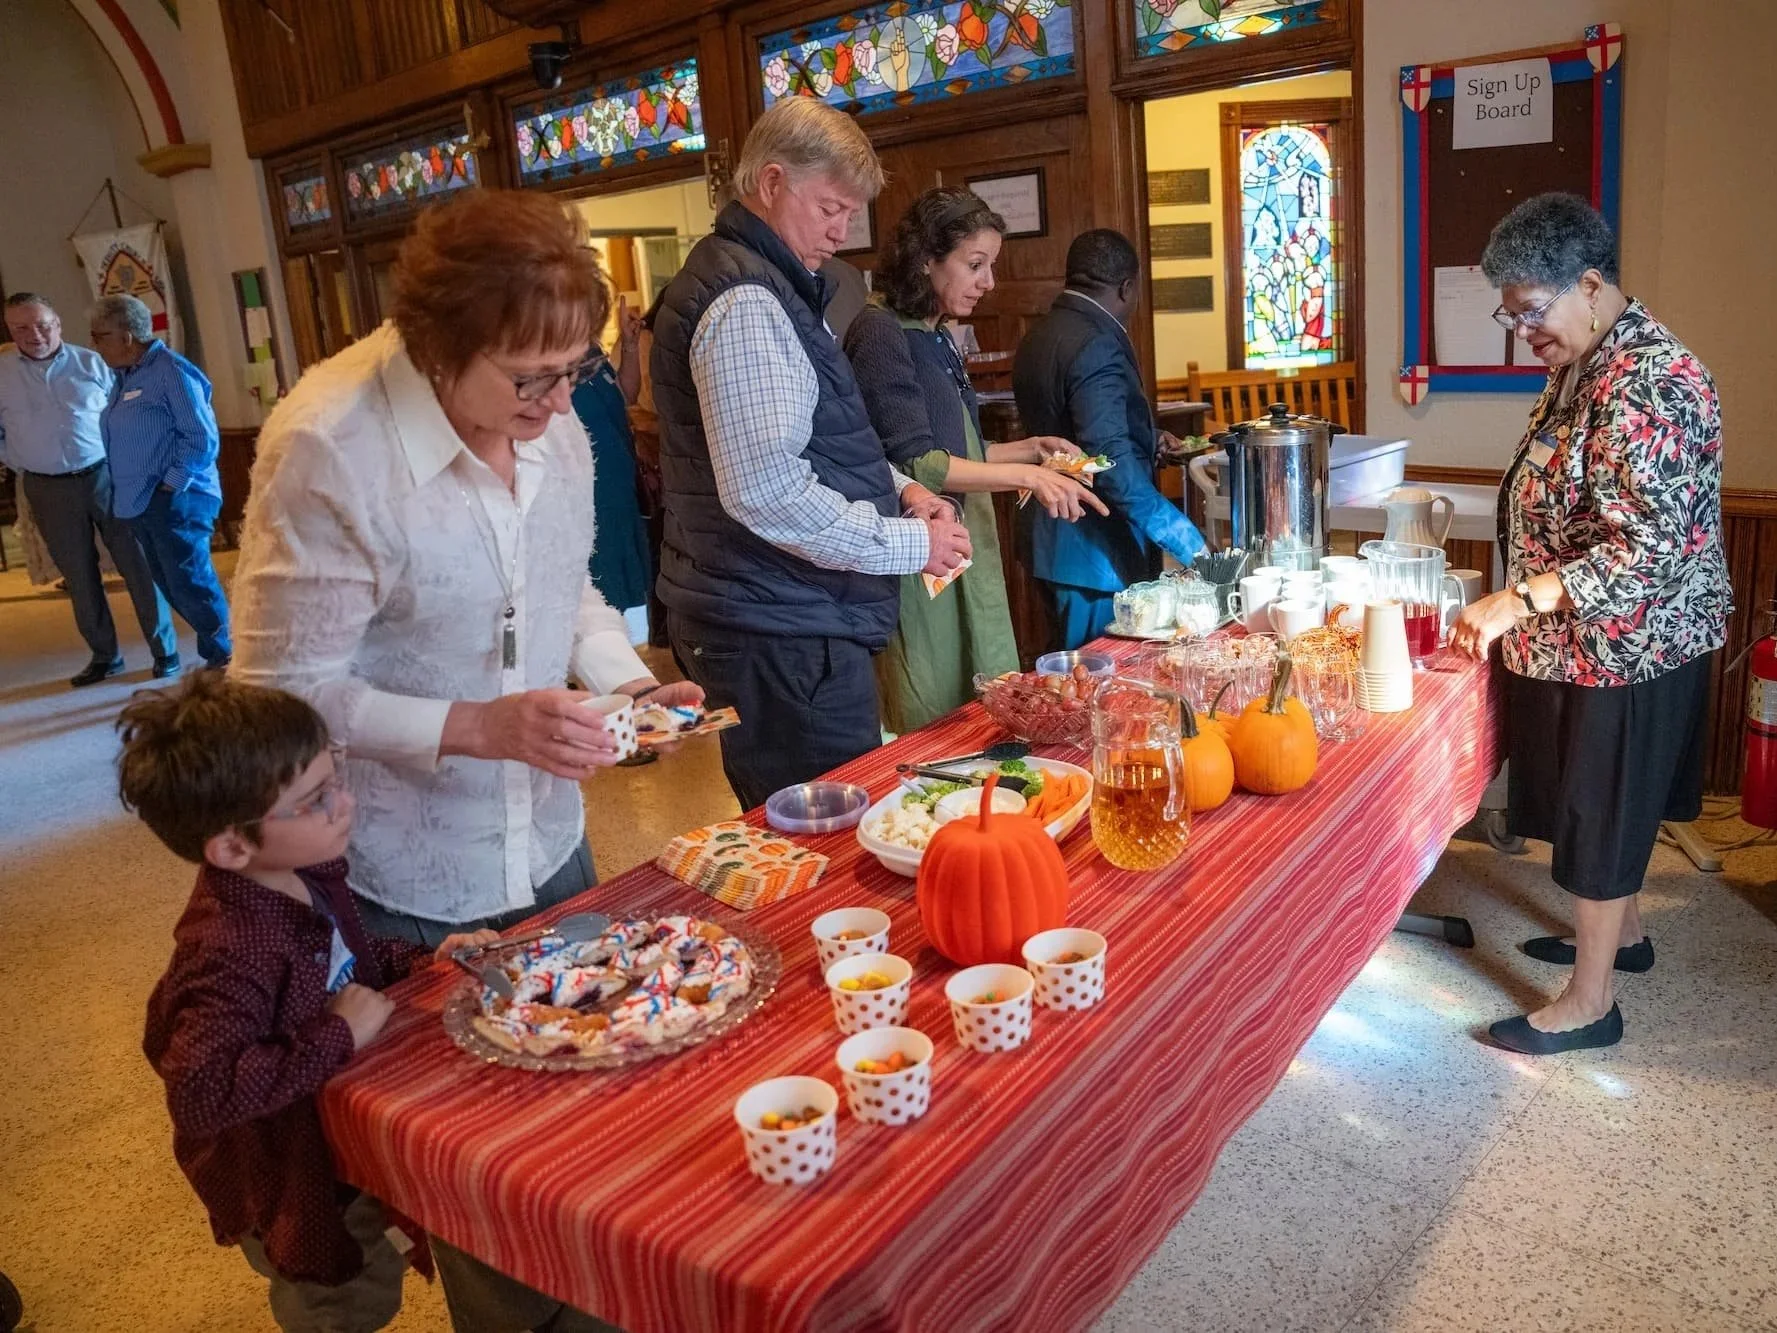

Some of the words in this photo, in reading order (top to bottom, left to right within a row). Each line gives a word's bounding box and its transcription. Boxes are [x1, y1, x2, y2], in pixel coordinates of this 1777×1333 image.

[1467, 77, 1507, 99] Sign
[1515, 73, 1541, 95] Up
[1475, 97, 1531, 120] Board
